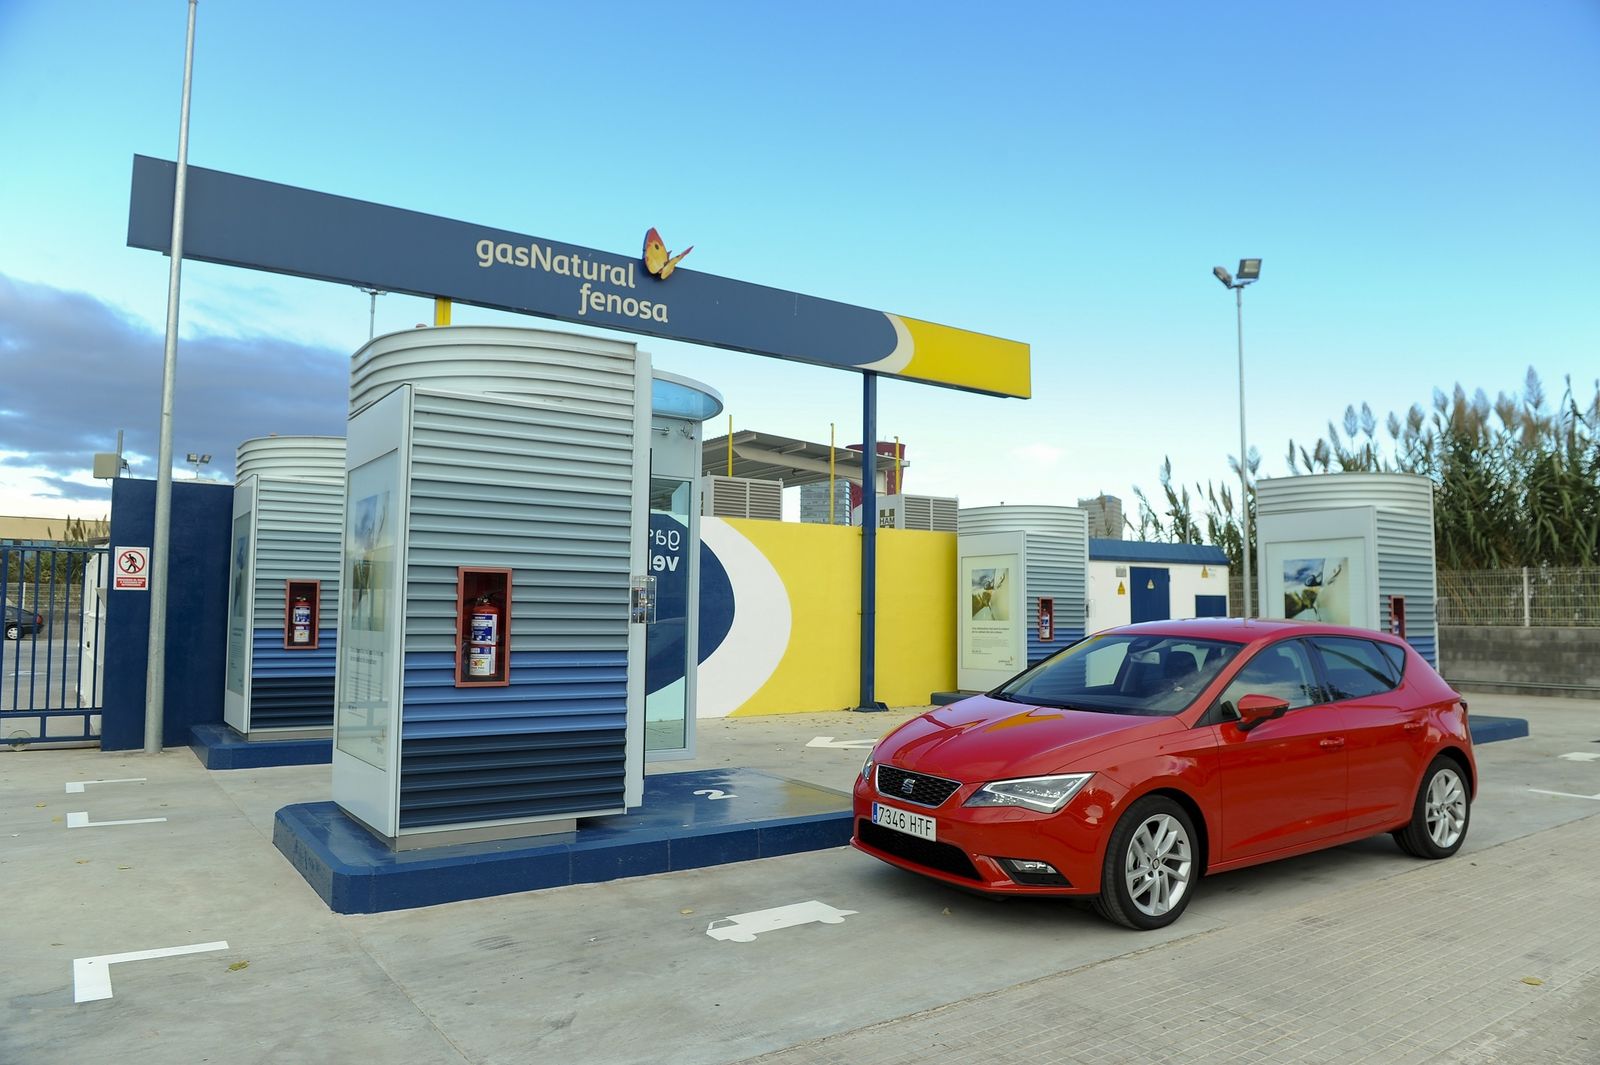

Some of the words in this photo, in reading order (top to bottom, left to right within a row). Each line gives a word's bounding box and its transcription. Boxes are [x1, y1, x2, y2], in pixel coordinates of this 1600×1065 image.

[476, 239, 636, 289] gasNatural
[578, 282, 669, 324] fenosa
[879, 806, 906, 829] 7346
[909, 815, 933, 837] HTF
